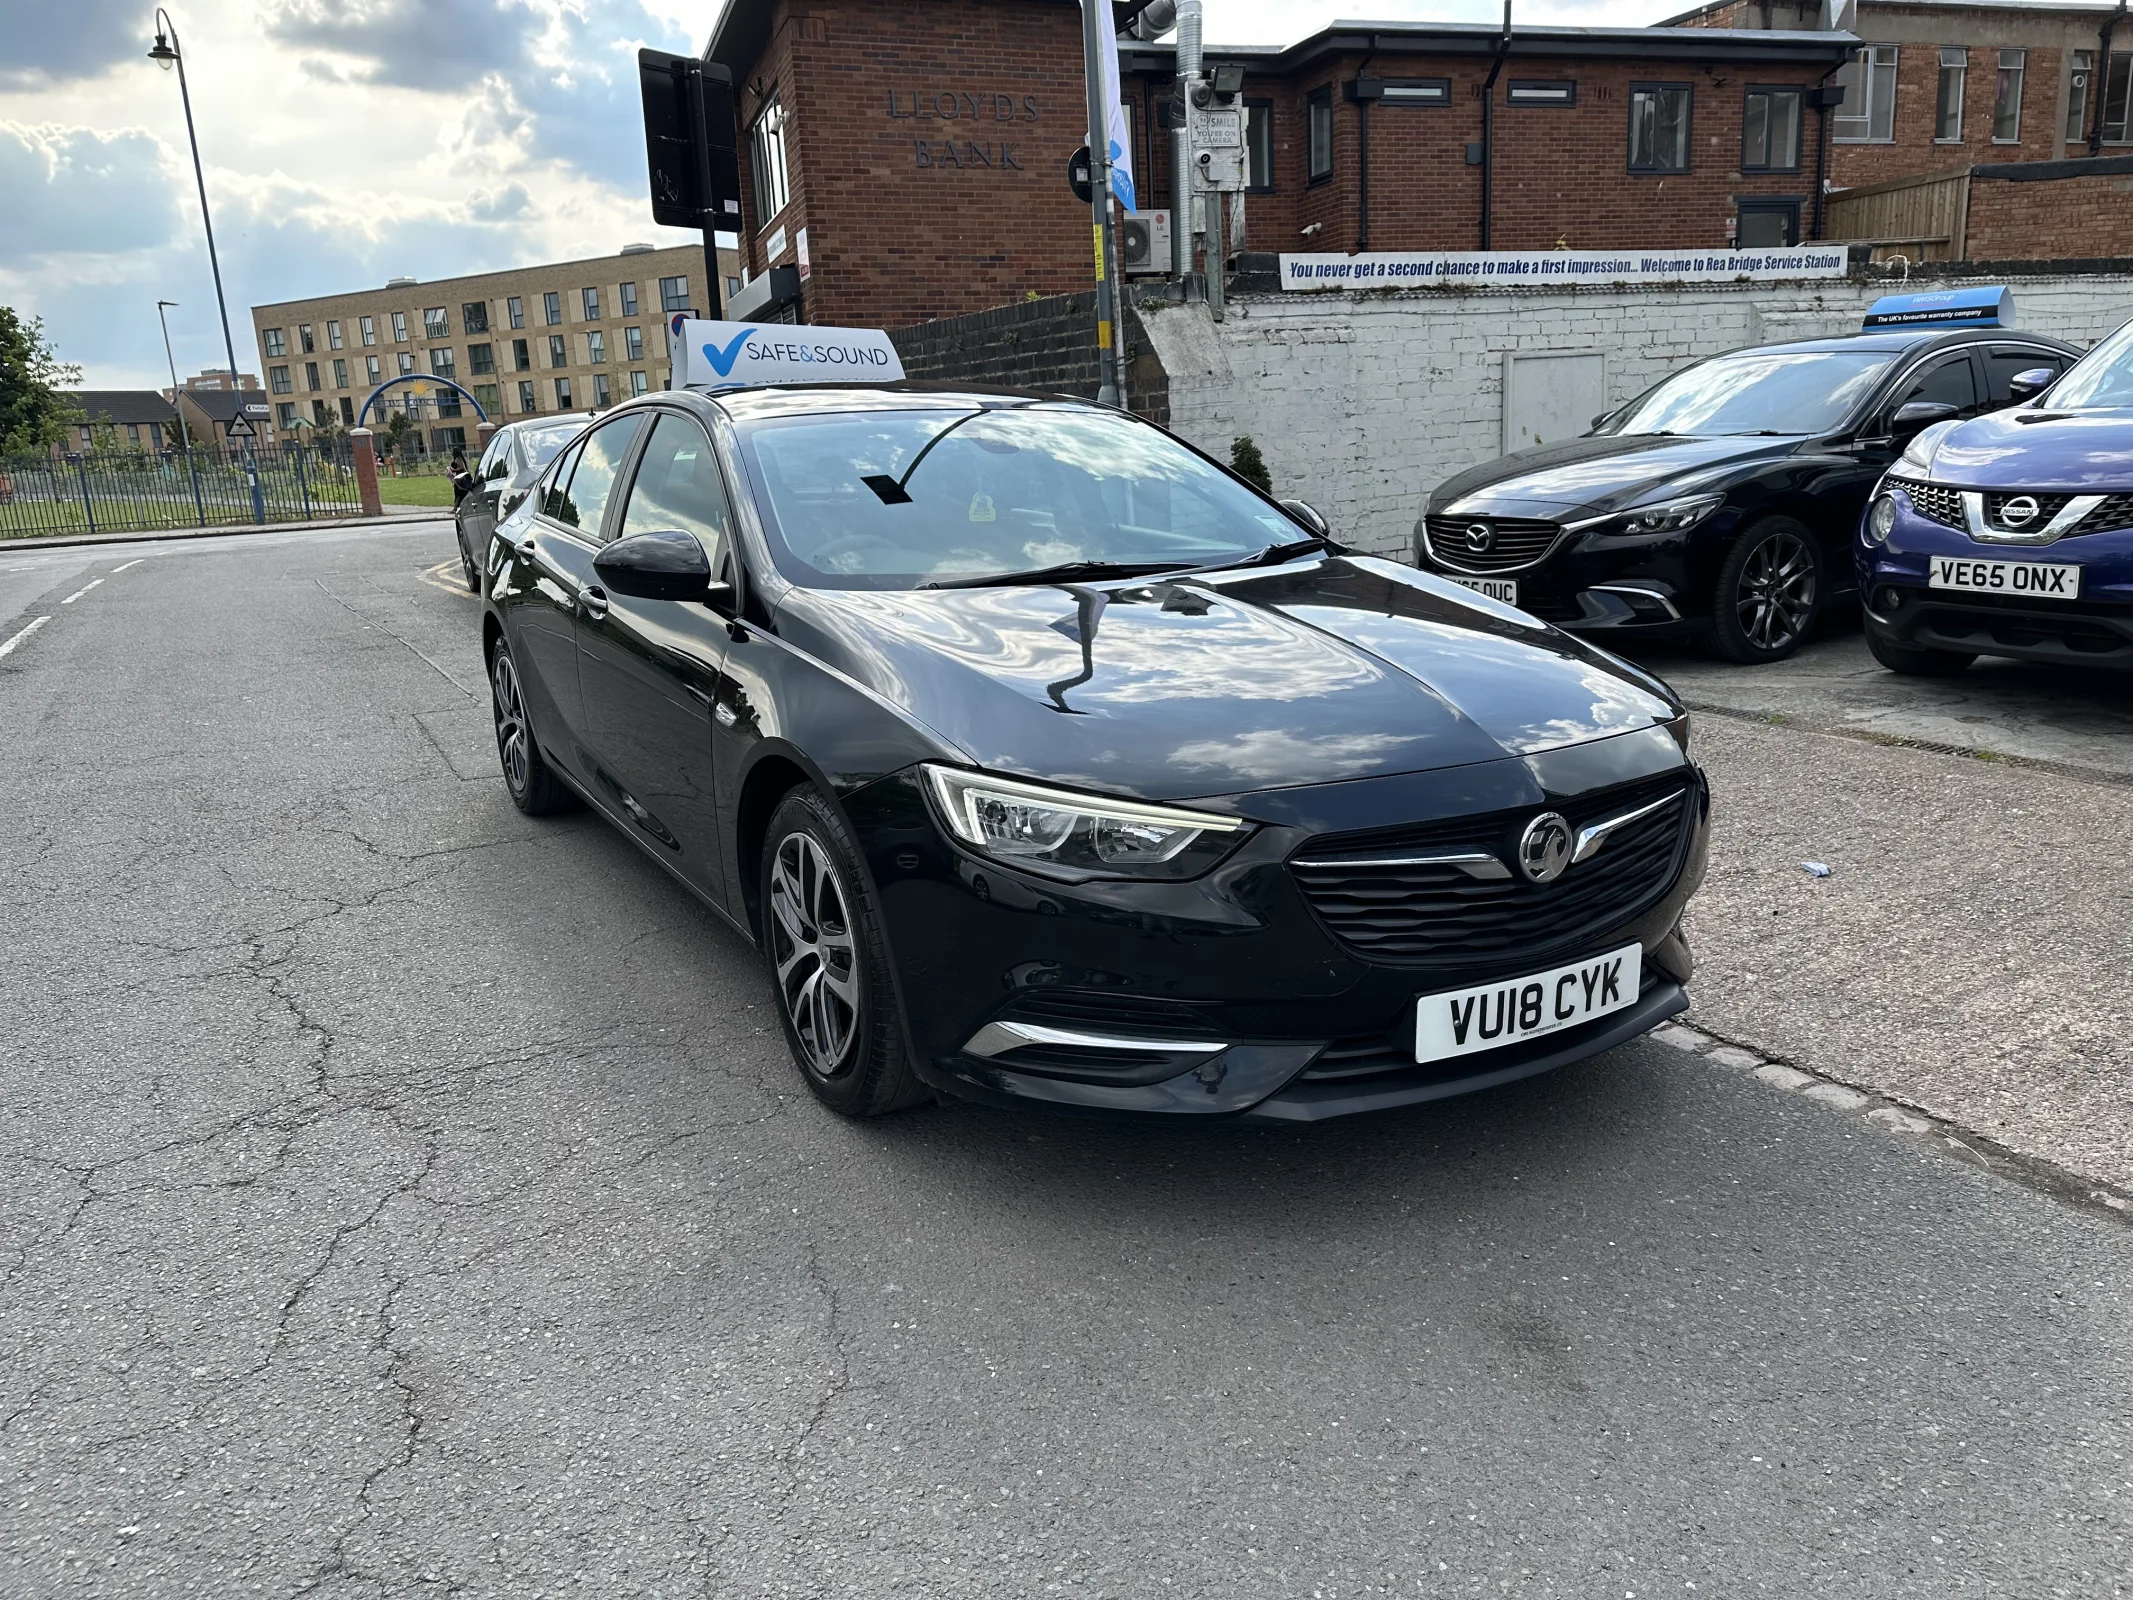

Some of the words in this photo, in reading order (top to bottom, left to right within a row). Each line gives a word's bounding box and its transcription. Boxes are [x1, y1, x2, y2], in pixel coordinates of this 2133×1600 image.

[888, 89, 1038, 122] LLOYDS
[1211, 117, 1236, 127] SMILE
[915, 139, 1026, 170] BANK
[1290, 261, 1312, 278] You
[1315, 264, 1351, 277] never
[1354, 262, 1376, 279] get
[1378, 264, 1386, 277] a
[1388, 260, 1433, 276] second
[1435, 260, 1480, 276] chance
[1482, 261, 1495, 275] to
[1497, 259, 1529, 274] make
[1531, 261, 1539, 274] a
[1541, 258, 1565, 274] first
[1567, 258, 1638, 275] impression...
[1640, 257, 1691, 272] Welcome
[1693, 258, 1704, 271] to
[1706, 257, 1726, 271] Rea
[1728, 256, 1762, 272] Bridge
[1764, 254, 1802, 270] Service
[1804, 254, 1840, 269] Station
[1929, 311, 1953, 319] warranty
[1955, 309, 1982, 317] company
[746, 342, 888, 366] SAFE&SOUND
[1941, 561, 2005, 588] VE65
[2013, 566, 2067, 592] ONX
[1450, 982, 1543, 1046] VU18
[1555, 957, 1622, 1021] CYK
